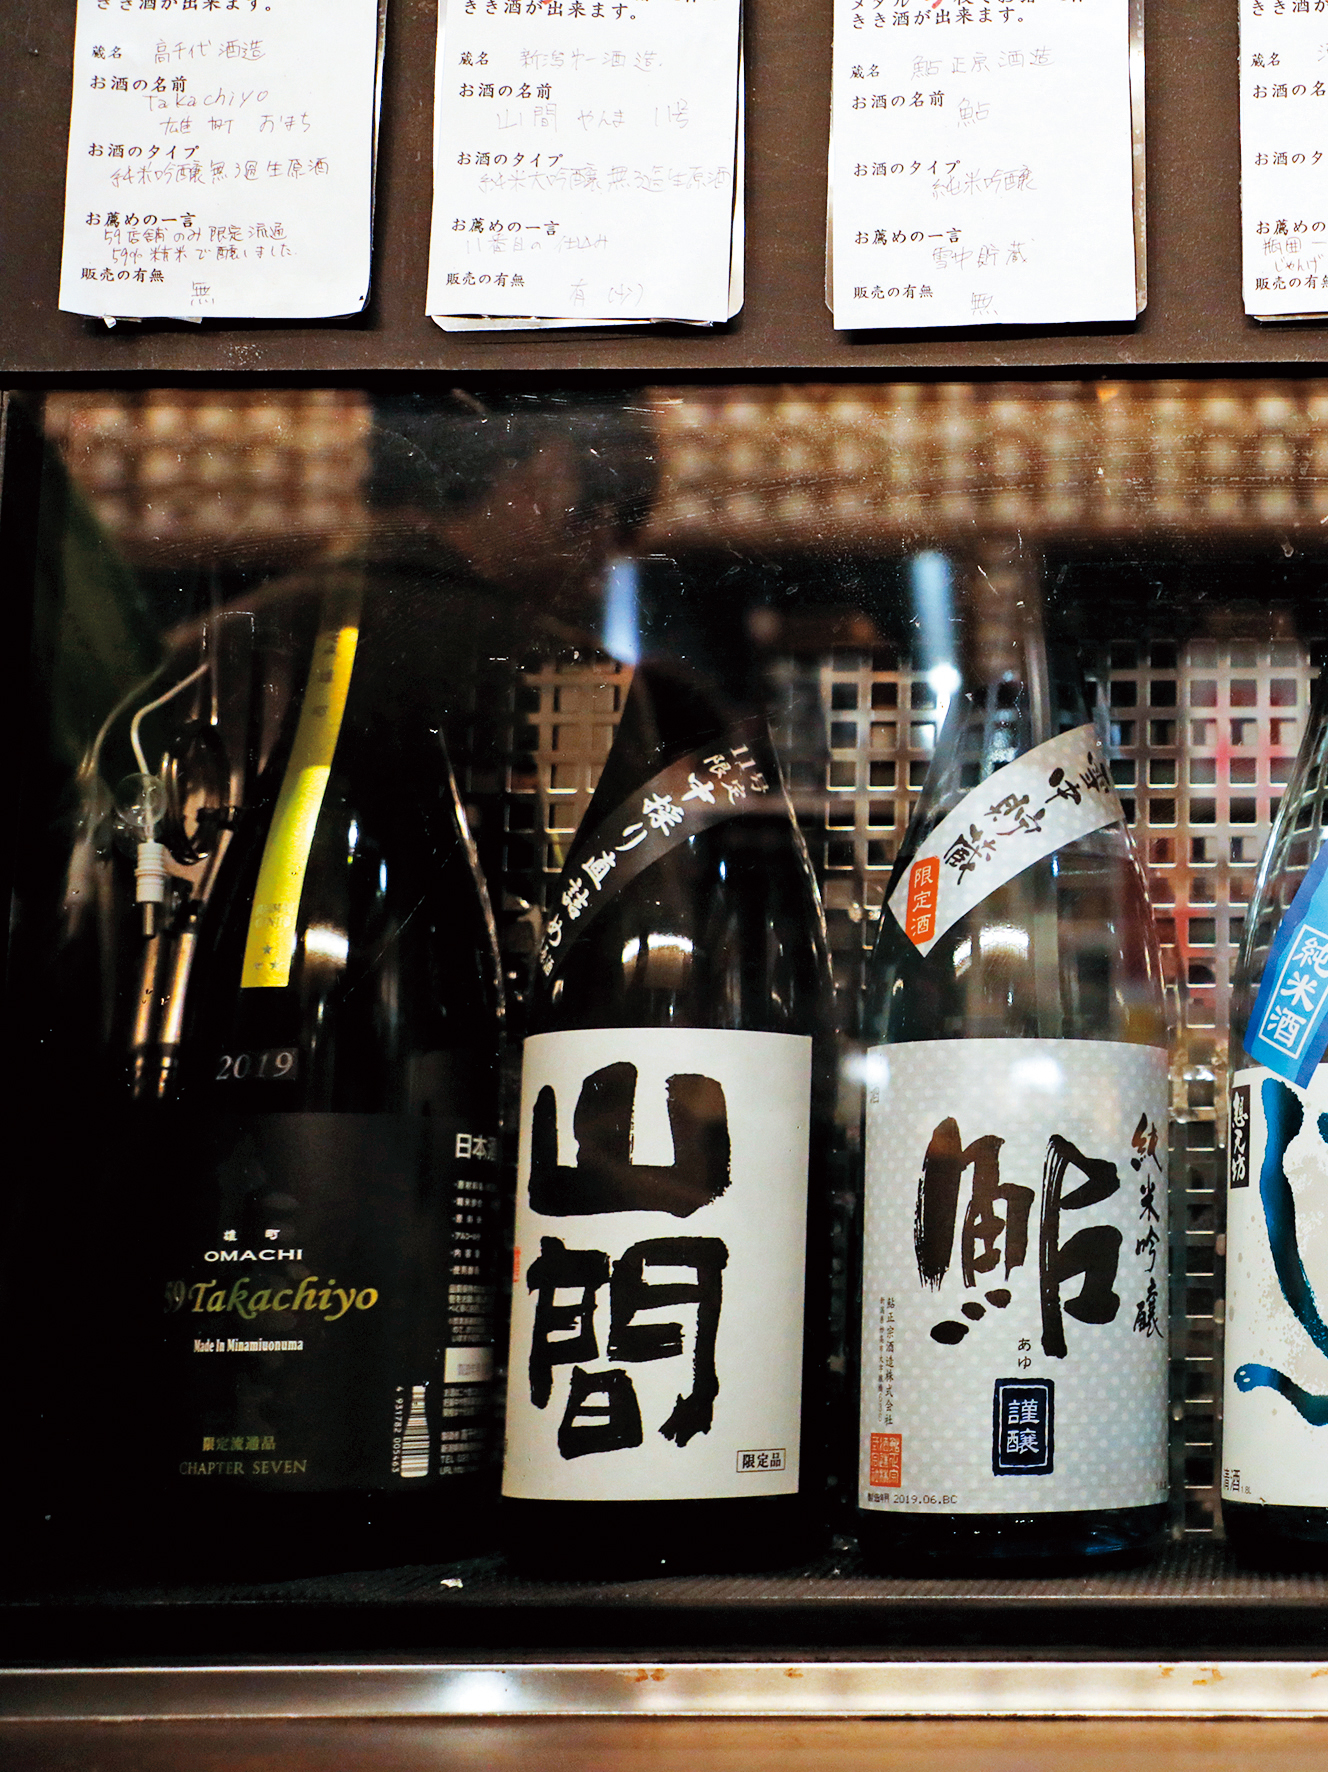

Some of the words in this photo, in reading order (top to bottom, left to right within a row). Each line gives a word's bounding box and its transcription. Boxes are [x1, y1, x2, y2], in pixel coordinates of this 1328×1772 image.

[464, 0, 637, 20] きき酒が出来ます。
[851, 7, 1024, 29] きき酒が出来ます。
[91, 46, 122, 60] 蔵名
[154, 39, 266, 63] 高千代酒造
[458, 51, 489, 66] 蔵名
[1250, 52, 1281, 68] 蔵名
[850, 64, 881, 79] 蔵名
[90, 75, 188, 93] お酒の名前
[459, 83, 552, 100] お酒の名前
[852, 90, 945, 110] お酒の名前
[496, 103, 557, 132] 山間
[957, 97, 991, 129] 鮎
[88, 144, 200, 159] お酒のタイプ
[457, 152, 564, 167] お酒のタイプ
[854, 159, 961, 177] お酒のタイプ
[85, 212, 196, 229] お薦めの一言
[451, 218, 560, 236] お薦めの一言
[855, 227, 963, 246] お薦めの一言
[81, 268, 165, 282] 販売の有無
[446, 272, 525, 287] 販売の有無
[191, 281, 215, 306] 無
[853, 284, 934, 300] 販売の有無
[971, 292, 998, 315] 無
[911, 864, 933, 937] 限定酒
[215, 1051, 294, 1081] 2019
[1130, 1112, 1164, 1339] 純米吟醸
[914, 1116, 1123, 1359] 鮎
[204, 1249, 304, 1262] OMACHI
[527, 1061, 732, 1460] 山間
[188, 1276, 379, 1321] Takachiyo
[193, 1339, 215, 1353] Made
[227, 1338, 304, 1352] Minamiuonuma
[1017, 1337, 1032, 1371] あゆ
[1006, 1399, 1040, 1455] 謹醸
[179, 1461, 245, 1475] CHAPTER
[252, 1459, 307, 1474] SEVEN
[741, 1452, 783, 1470] 限定品
